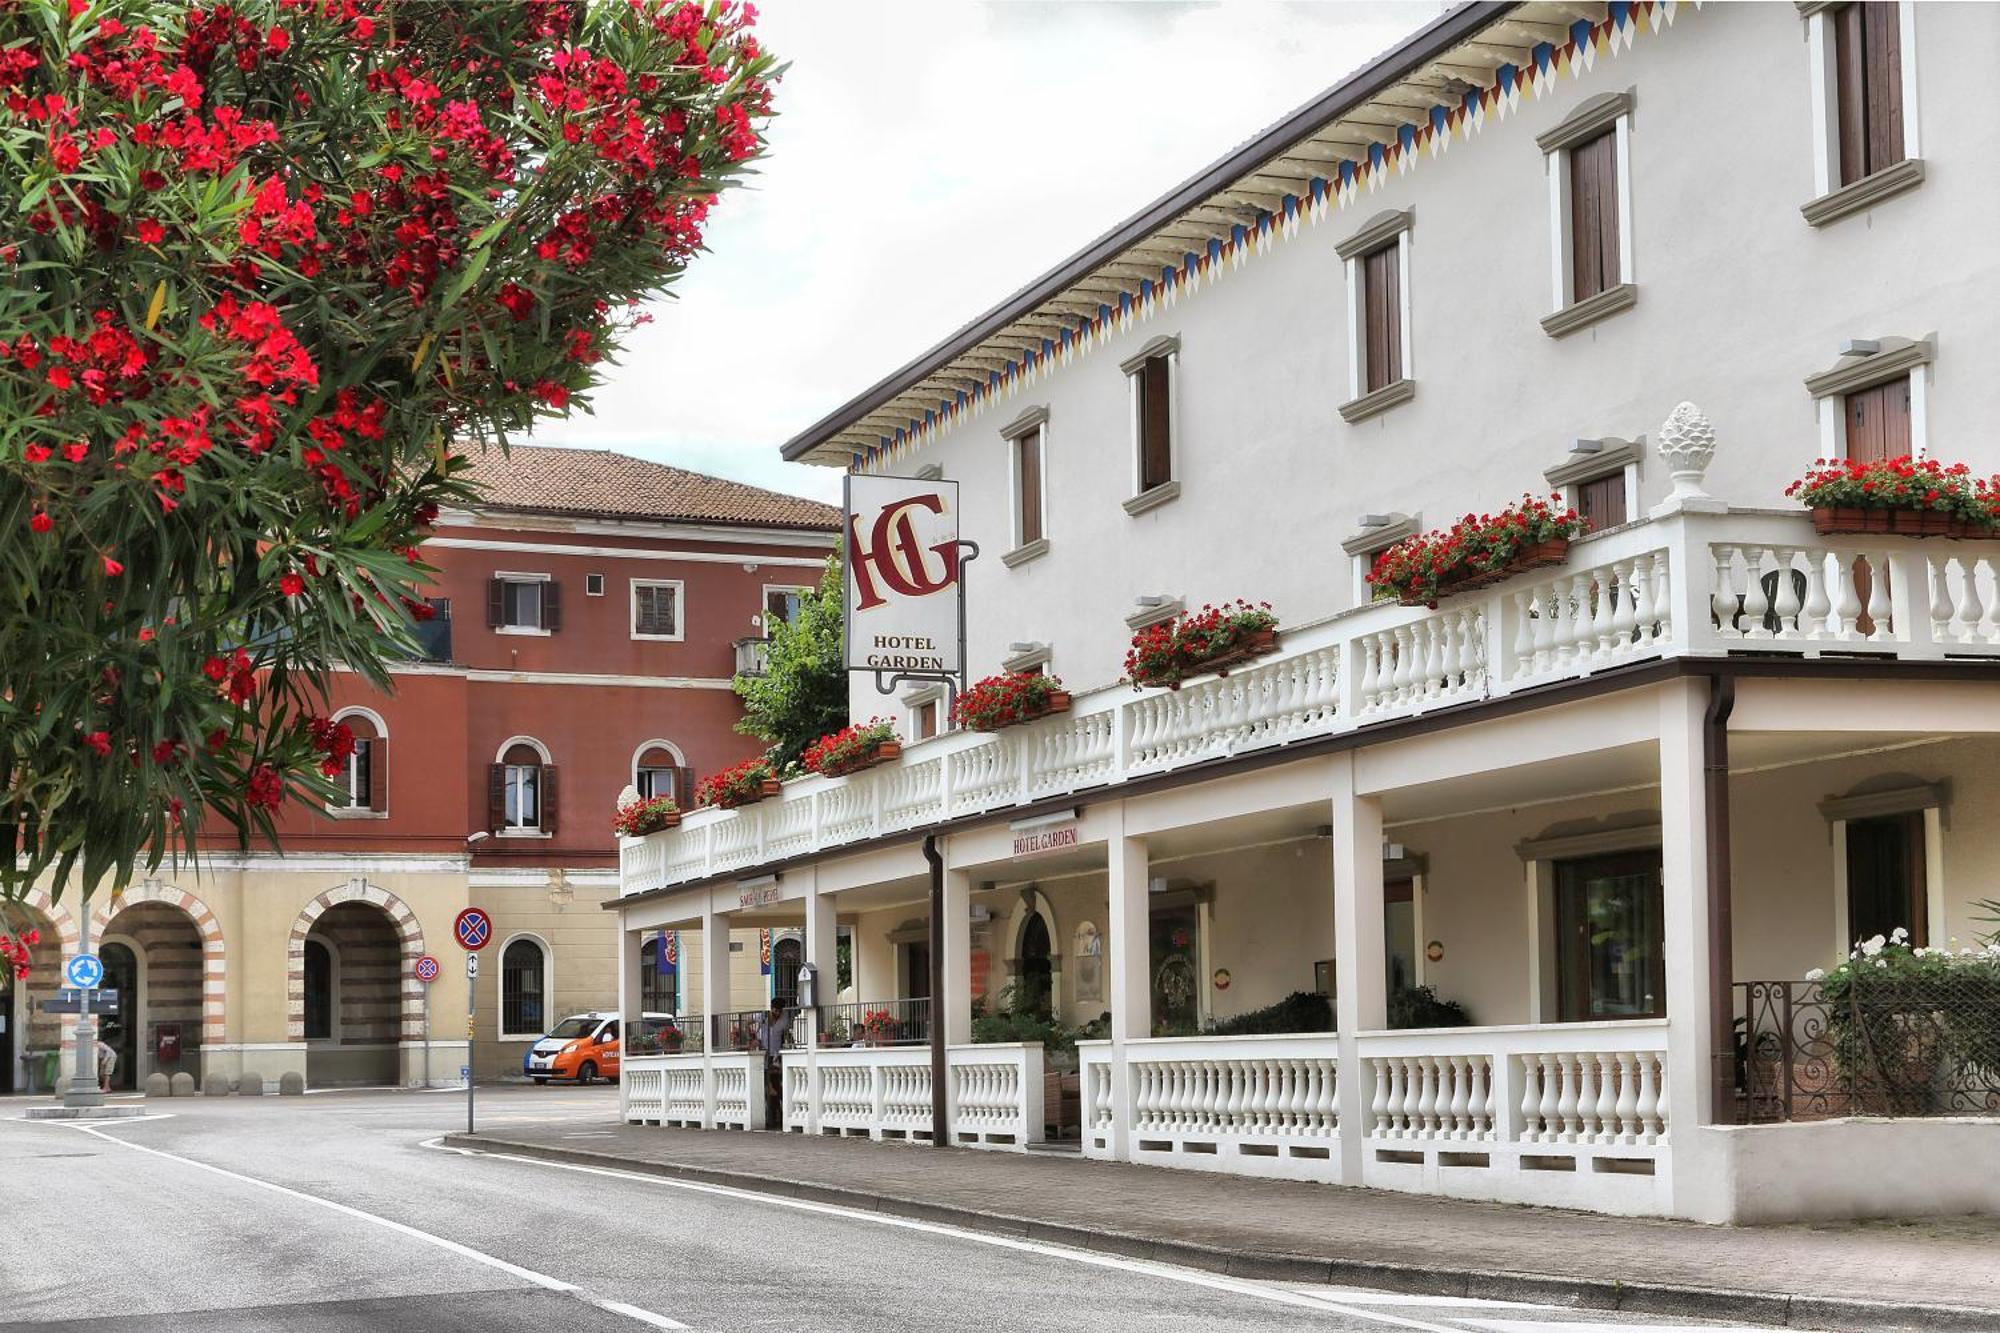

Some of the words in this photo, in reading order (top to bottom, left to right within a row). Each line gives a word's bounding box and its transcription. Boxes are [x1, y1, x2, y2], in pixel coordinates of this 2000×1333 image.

[874, 635, 936, 650] HOTEL
[867, 654, 943, 669] GARDEN
[1014, 835, 1041, 854] HOTEL
[1041, 827, 1077, 849] GARDEN
